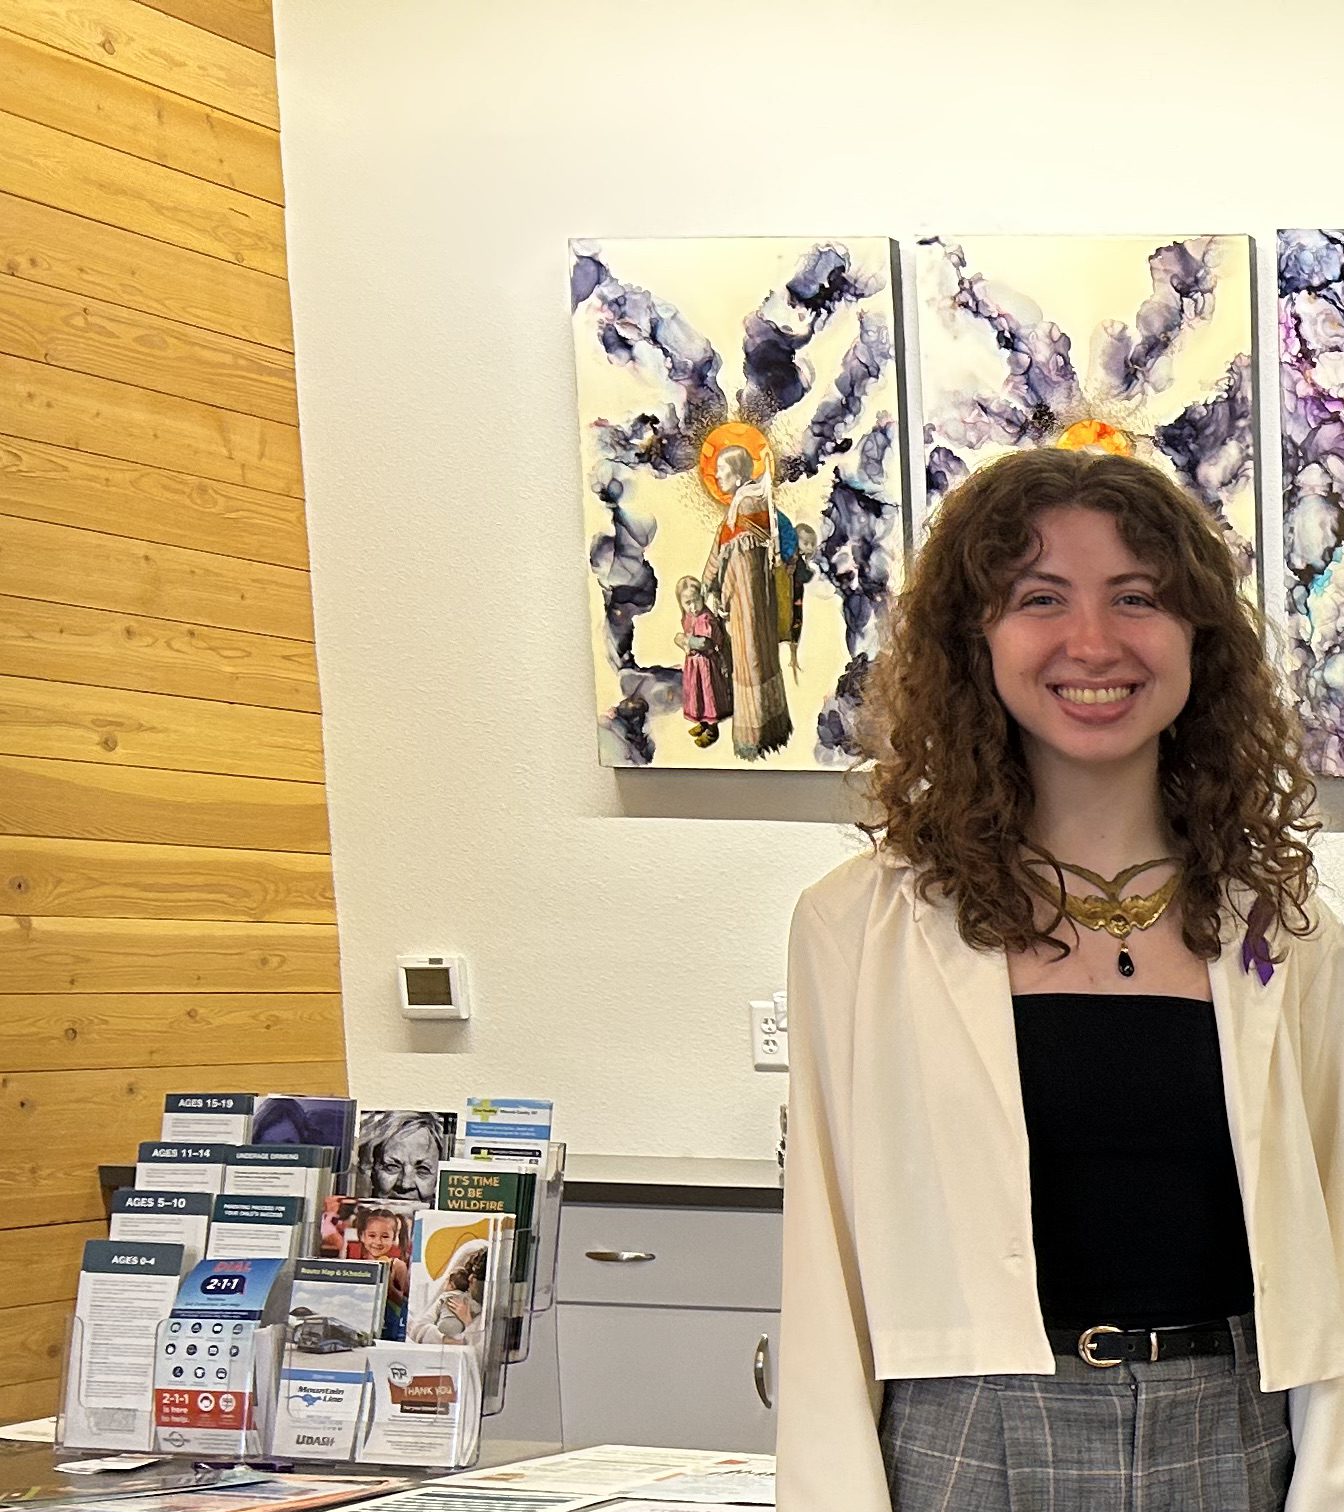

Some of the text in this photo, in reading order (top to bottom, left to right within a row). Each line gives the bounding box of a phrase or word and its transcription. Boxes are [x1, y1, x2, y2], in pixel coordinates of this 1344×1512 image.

[178, 1098, 234, 1108] AGES 15-19
[151, 1148, 178, 1157] AGES
[448, 1175, 500, 1187] IT'S TIME
[448, 1187, 484, 1198] TO BE
[125, 1197, 155, 1207] AGES
[447, 1200, 505, 1211] WILDFIRE
[111, 1255, 138, 1265] AGES
[297, 1386, 345, 1395] Mountain
[162, 1393, 190, 1405] 2-1-1
